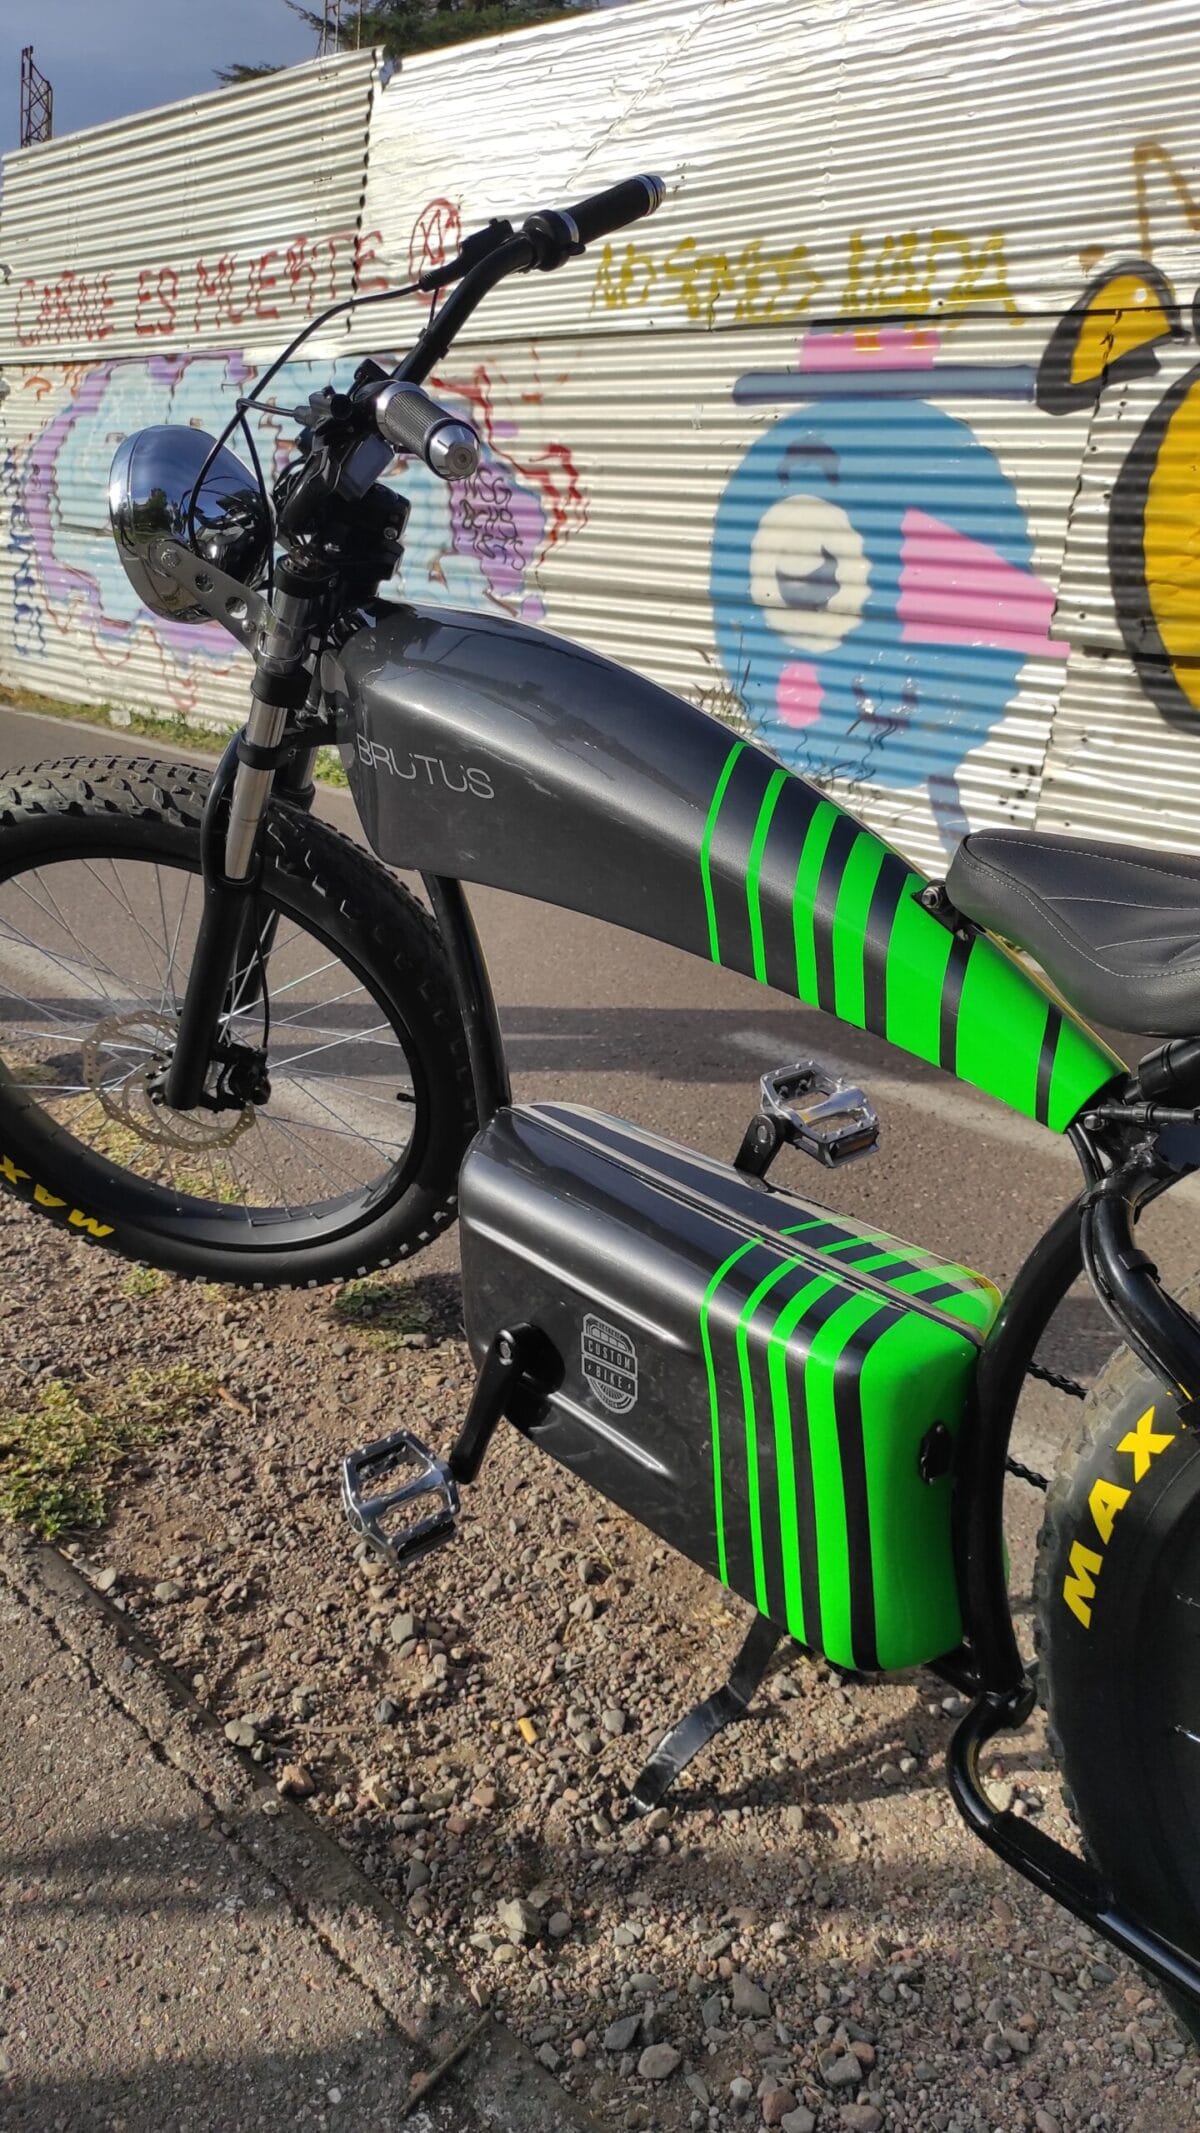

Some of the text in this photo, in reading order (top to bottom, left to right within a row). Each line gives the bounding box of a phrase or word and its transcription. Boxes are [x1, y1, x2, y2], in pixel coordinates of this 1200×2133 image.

[193, 230, 389, 332] MUERTE
[357, 733, 495, 799] BRUTUS
[588, 1340, 631, 1369] CUSTOM
[596, 1365, 623, 1388] BIKE
[1063, 1383, 1193, 1629] MAX
